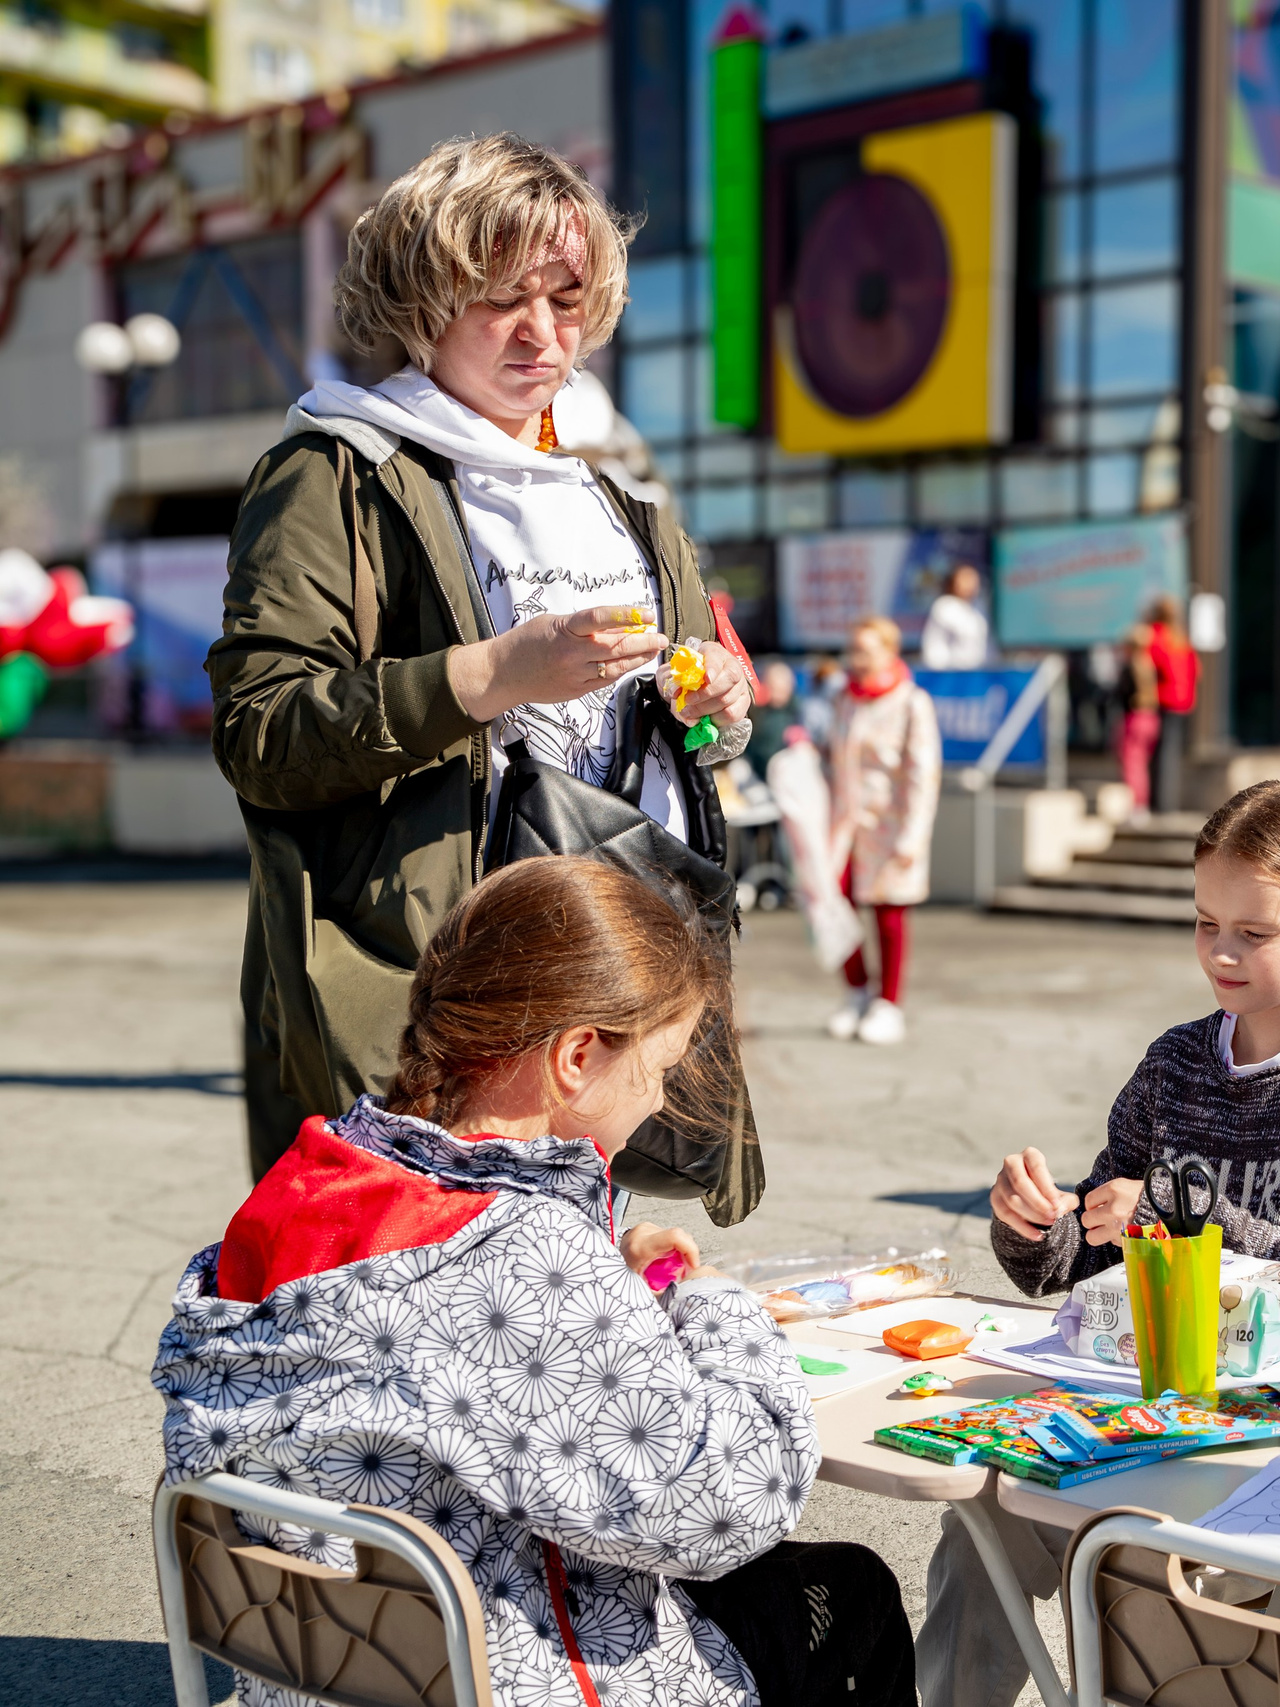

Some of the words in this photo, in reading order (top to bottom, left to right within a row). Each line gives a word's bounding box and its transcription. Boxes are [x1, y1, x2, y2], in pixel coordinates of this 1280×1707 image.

[724, 627, 740, 653] INSPIRED
[736, 654, 755, 681] YOUTH
[1236, 1329, 1255, 1342] 120
[1125, 1443, 1158, 1454] ЦВЕТНЫЕ
[1159, 1437, 1200, 1450] КАРАНДАШИ
[1081, 1469, 1107, 1480] ЦВЕТНЫЕ
[1108, 1458, 1141, 1473] КАРАНДАШИ
